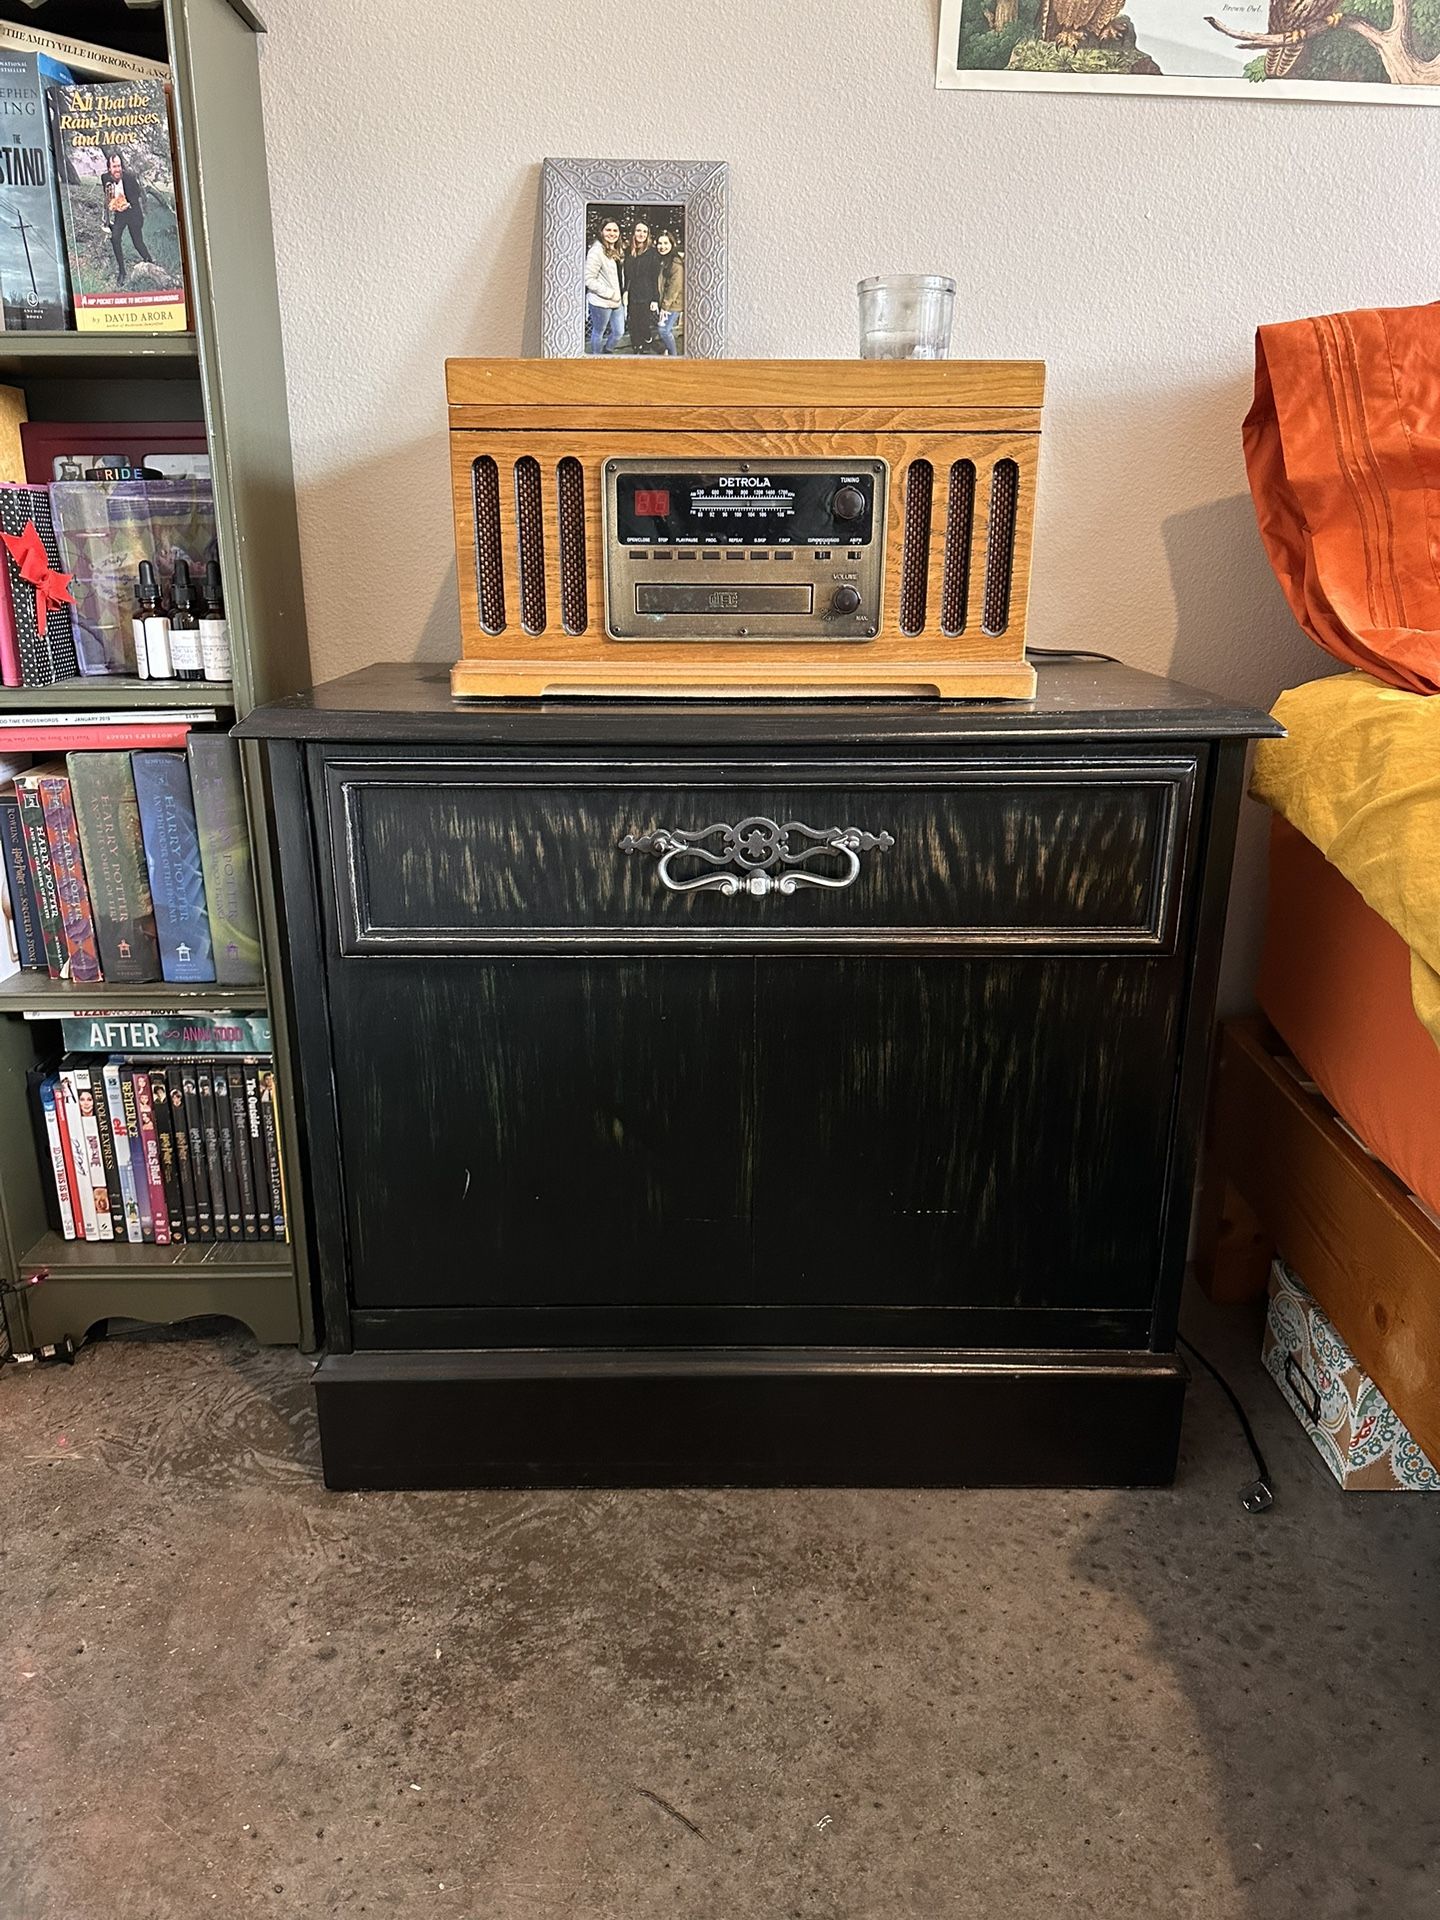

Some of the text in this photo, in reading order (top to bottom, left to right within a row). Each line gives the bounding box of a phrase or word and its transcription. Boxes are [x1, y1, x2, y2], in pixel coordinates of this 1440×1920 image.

[5, 27, 26, 41] THE
[26, 34, 86, 58] AMITYVILLE
[0, 101, 36, 116] ING
[96, 95, 125, 110] That
[128, 93, 151, 108] the
[71, 129, 100, 147] and
[104, 312, 138, 323] DAVID
[141, 311, 174, 322] ARORA
[96, 468, 143, 480] PRIDE
[719, 477, 771, 487] DETROLA
[61, 828, 75, 873] HARRY
[101, 796, 128, 922] HARRY POTTER
[165, 796, 189, 921] HARRY POTTER
[36, 826, 59, 918] HARRY POTTER
[224, 853, 238, 921] POTTER
[90, 1023, 160, 1048] AFTER
[246, 1078, 260, 1138] The Outsiders
[93, 1081, 115, 1170] THE POLAR EXPRESS
[113, 1118, 128, 1137] elf
[264, 1114, 274, 1143] perks
